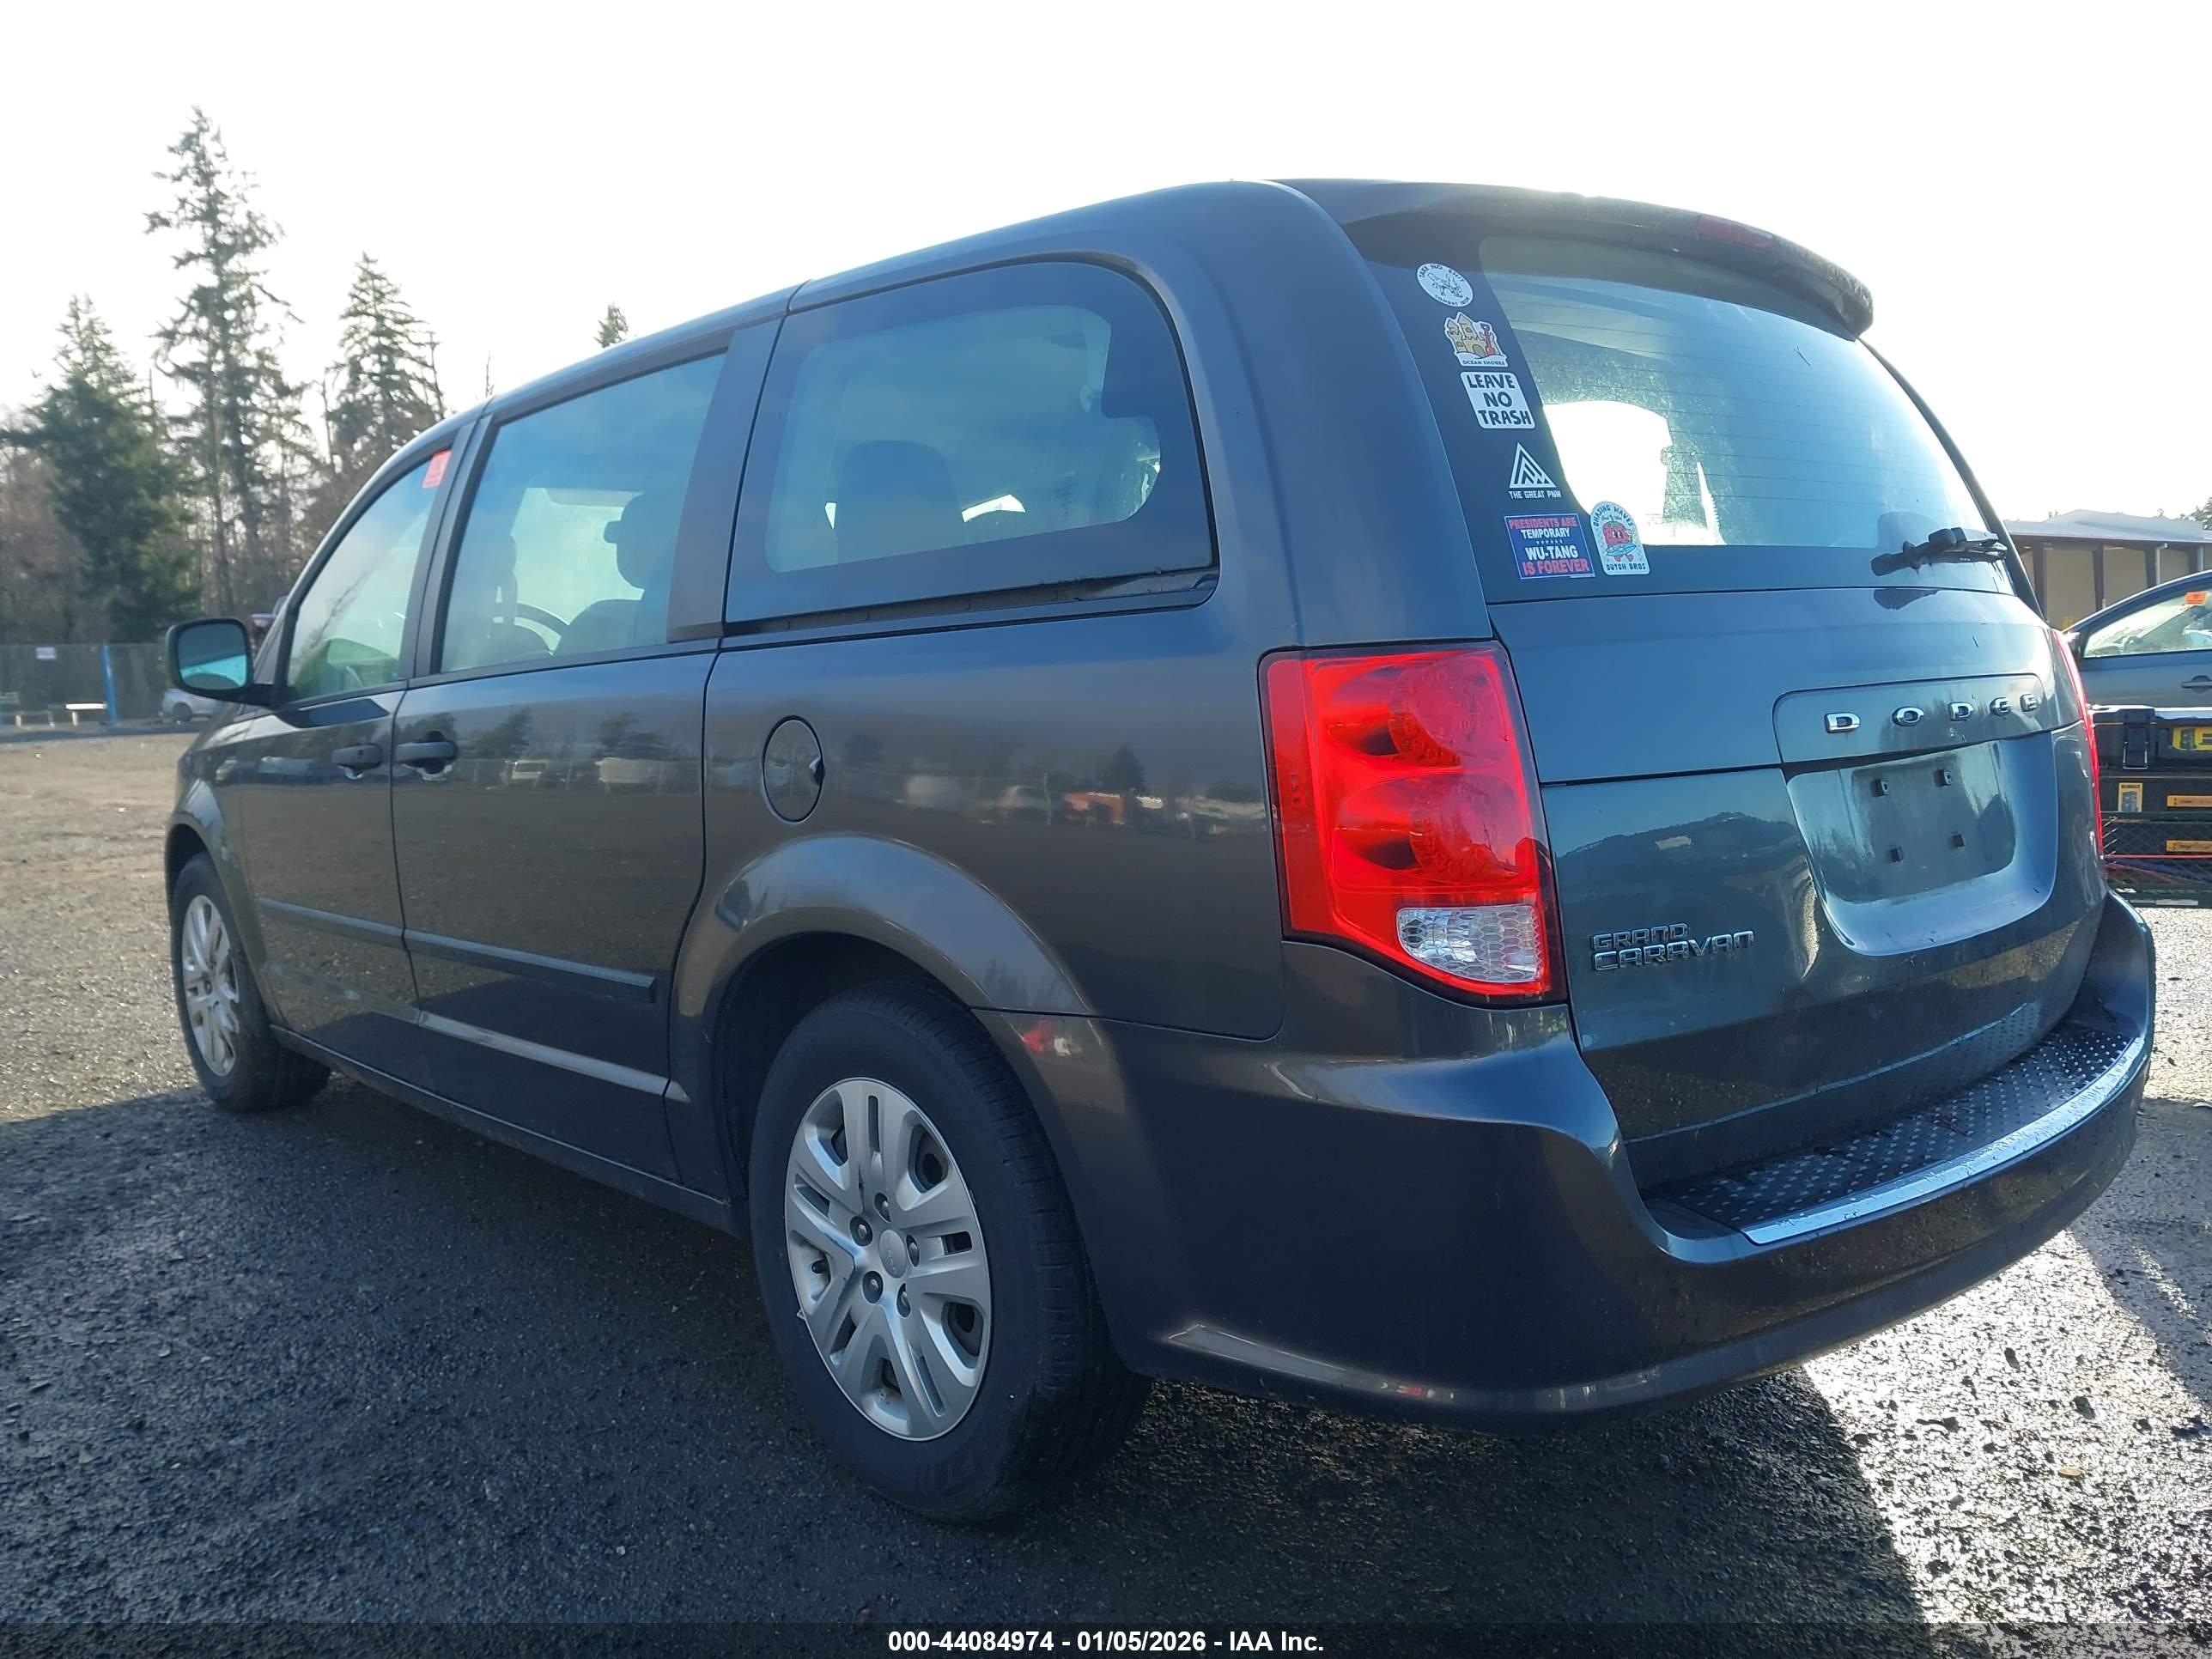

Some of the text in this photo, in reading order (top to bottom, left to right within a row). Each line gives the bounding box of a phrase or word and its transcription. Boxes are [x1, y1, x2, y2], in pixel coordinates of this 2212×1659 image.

[1467, 374, 1516, 389] LEAVE
[1482, 391, 1513, 407] NO
[1477, 410, 1532, 425] TRASH
[1508, 490, 1523, 499] THE
[1523, 490, 1545, 499] GREAT
[1508, 517, 1577, 529] PRESIDENTS ARE
[1593, 504, 1634, 526] CHASING WAVES
[1521, 527, 1571, 539] TEMPORARY
[1525, 545, 1579, 561] WU-TANG
[1522, 558, 1589, 575] IS FOREVER
[1606, 562, 1626, 571] DUTCH
[1825, 693, 2041, 733] DODGE
[1591, 922, 1689, 950] GRAND
[1594, 930, 1754, 971] CARAVAN
